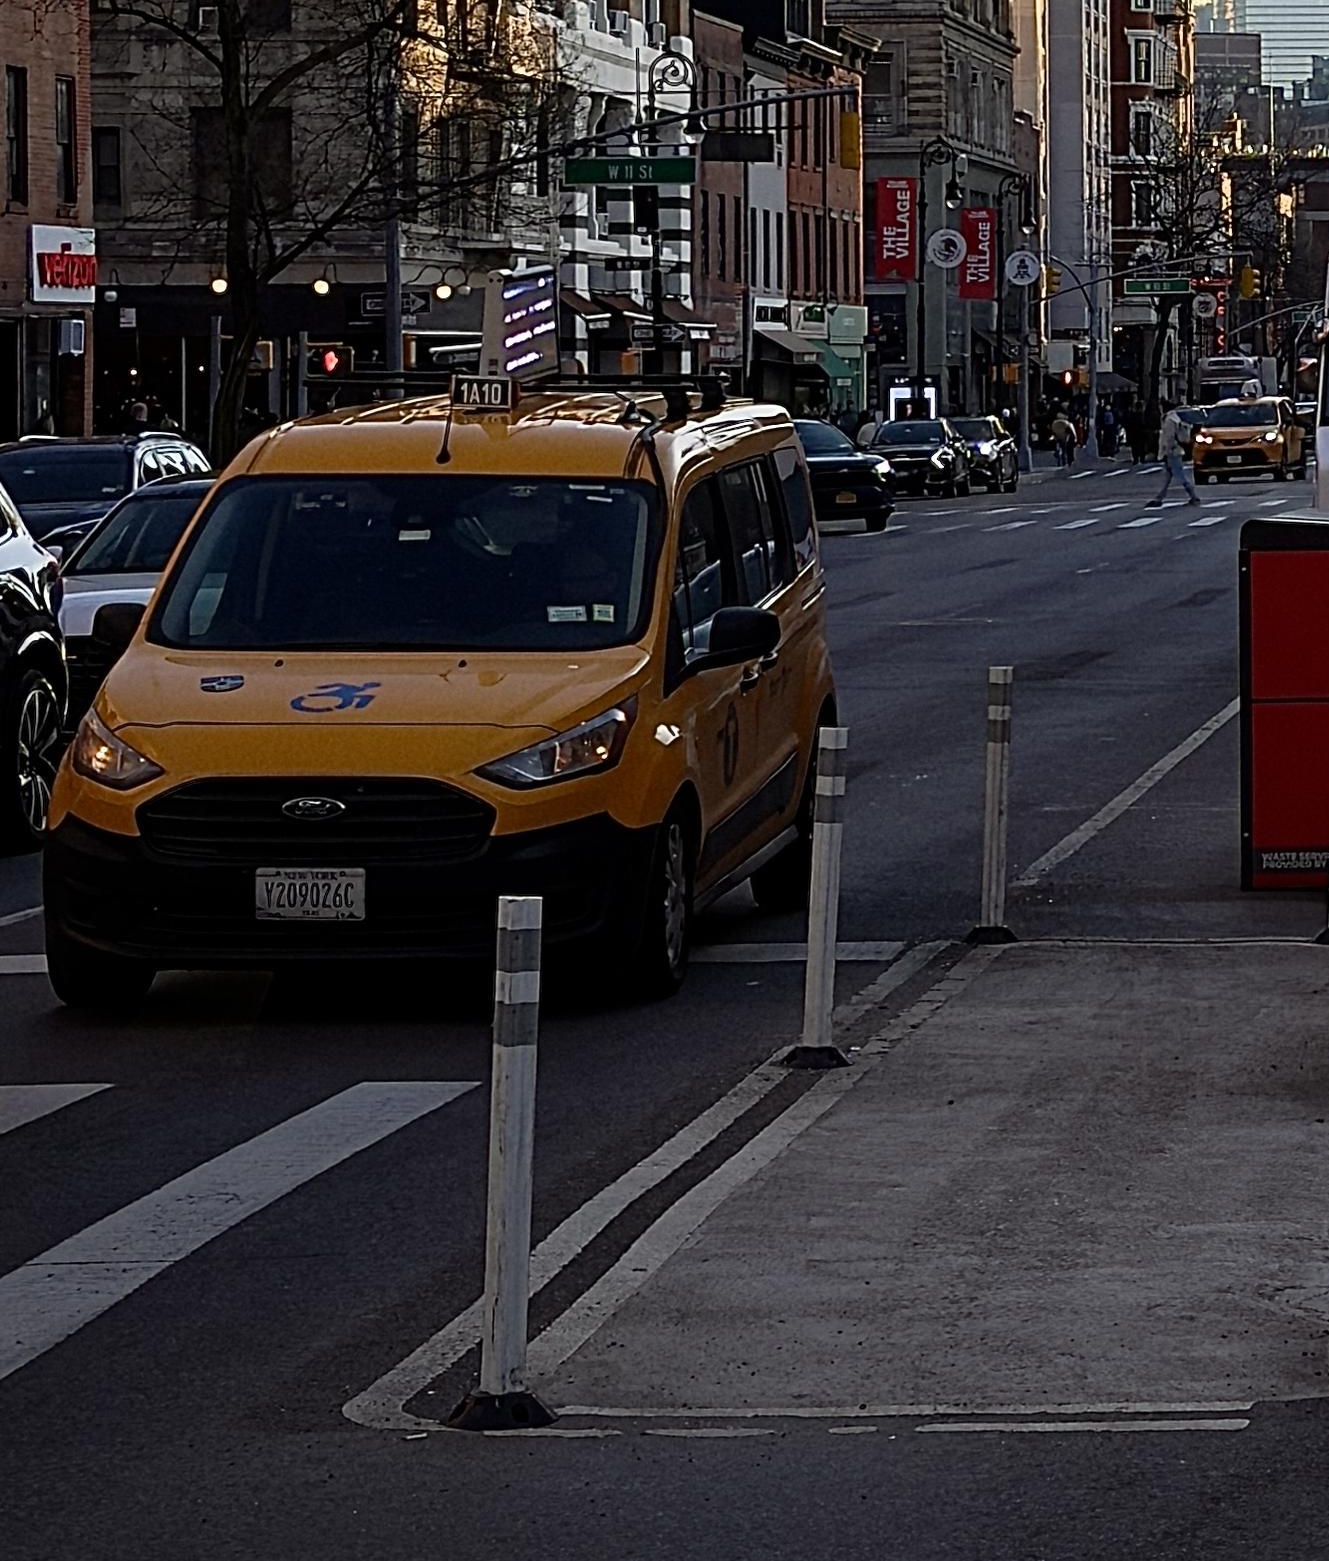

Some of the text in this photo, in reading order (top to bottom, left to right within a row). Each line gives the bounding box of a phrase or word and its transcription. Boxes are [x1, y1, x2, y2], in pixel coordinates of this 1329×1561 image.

[608, 164, 653, 180] W 11 St
[896, 189, 911, 260] VILLAGE
[883, 226, 897, 260] THE
[977, 222, 991, 283] VILLAGE
[37, 243, 98, 290] verizon
[460, 382, 502, 405] 1A10
[1261, 851, 1297, 861] WASTE
[1262, 859, 1328, 870] PROVIDED BY
[264, 881, 355, 909] Y209026C
